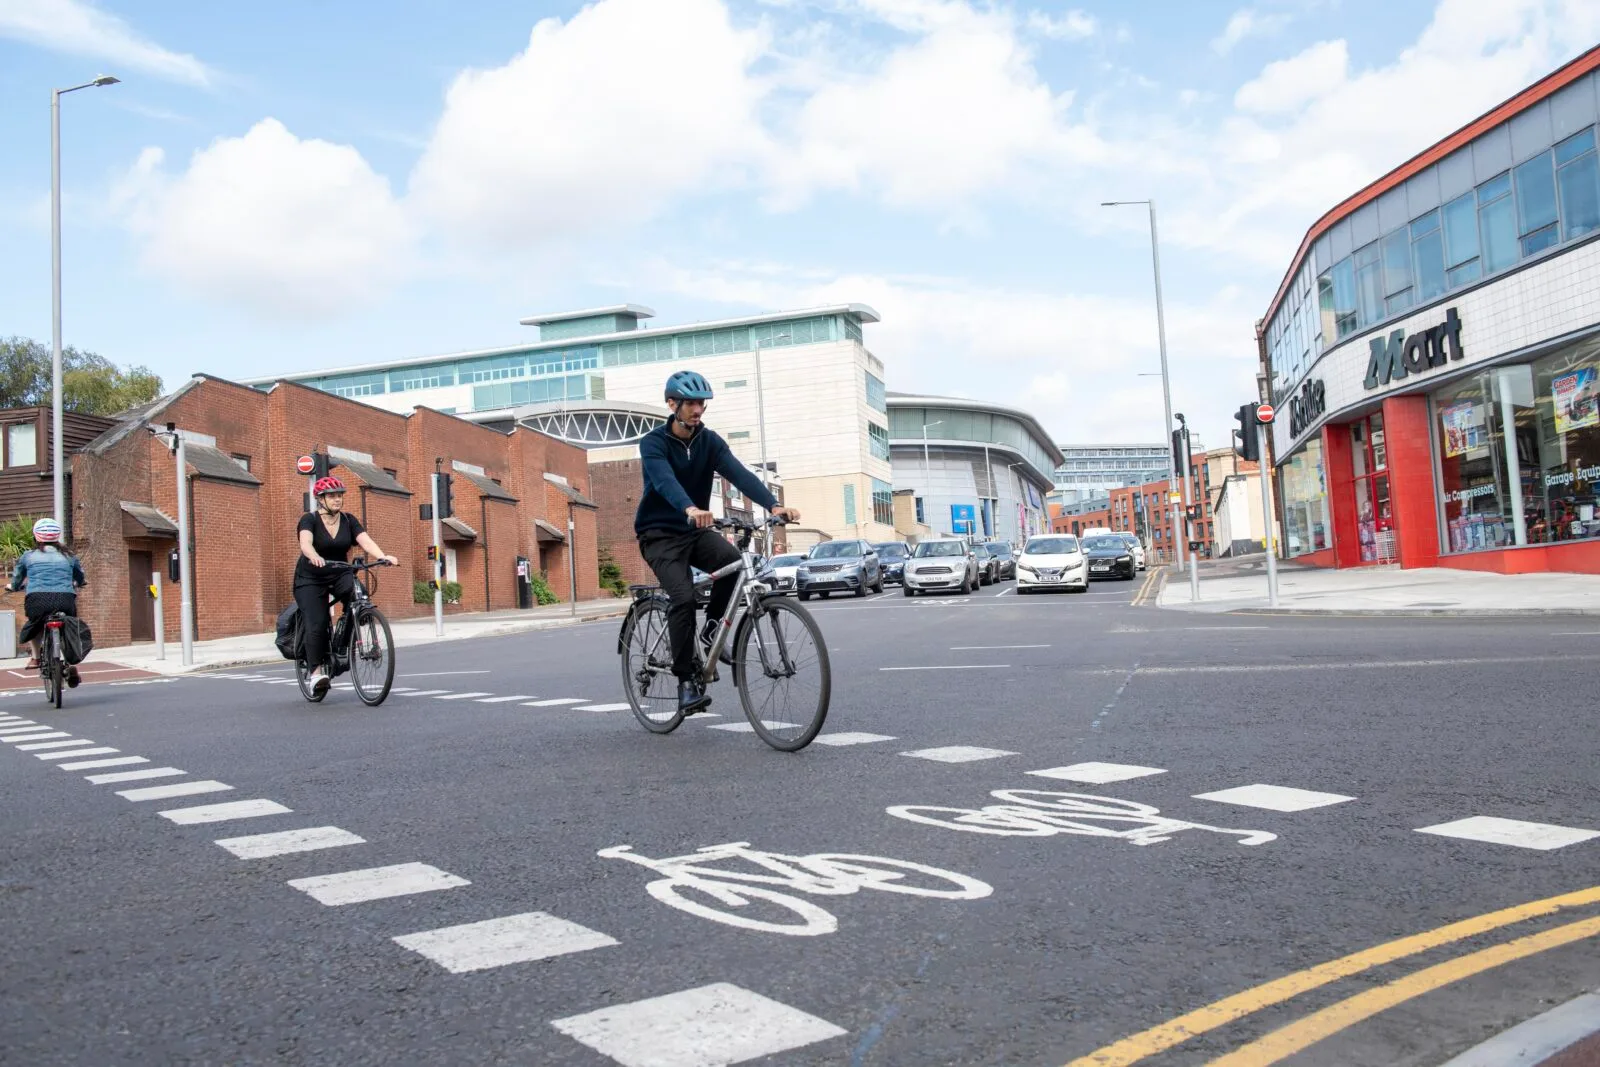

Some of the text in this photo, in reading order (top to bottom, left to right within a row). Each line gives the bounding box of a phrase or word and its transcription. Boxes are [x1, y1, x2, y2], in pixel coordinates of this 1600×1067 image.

[1363, 307, 1464, 390] Mart
[1545, 472, 1574, 486] Garage
[1576, 464, 1600, 481] Equip
